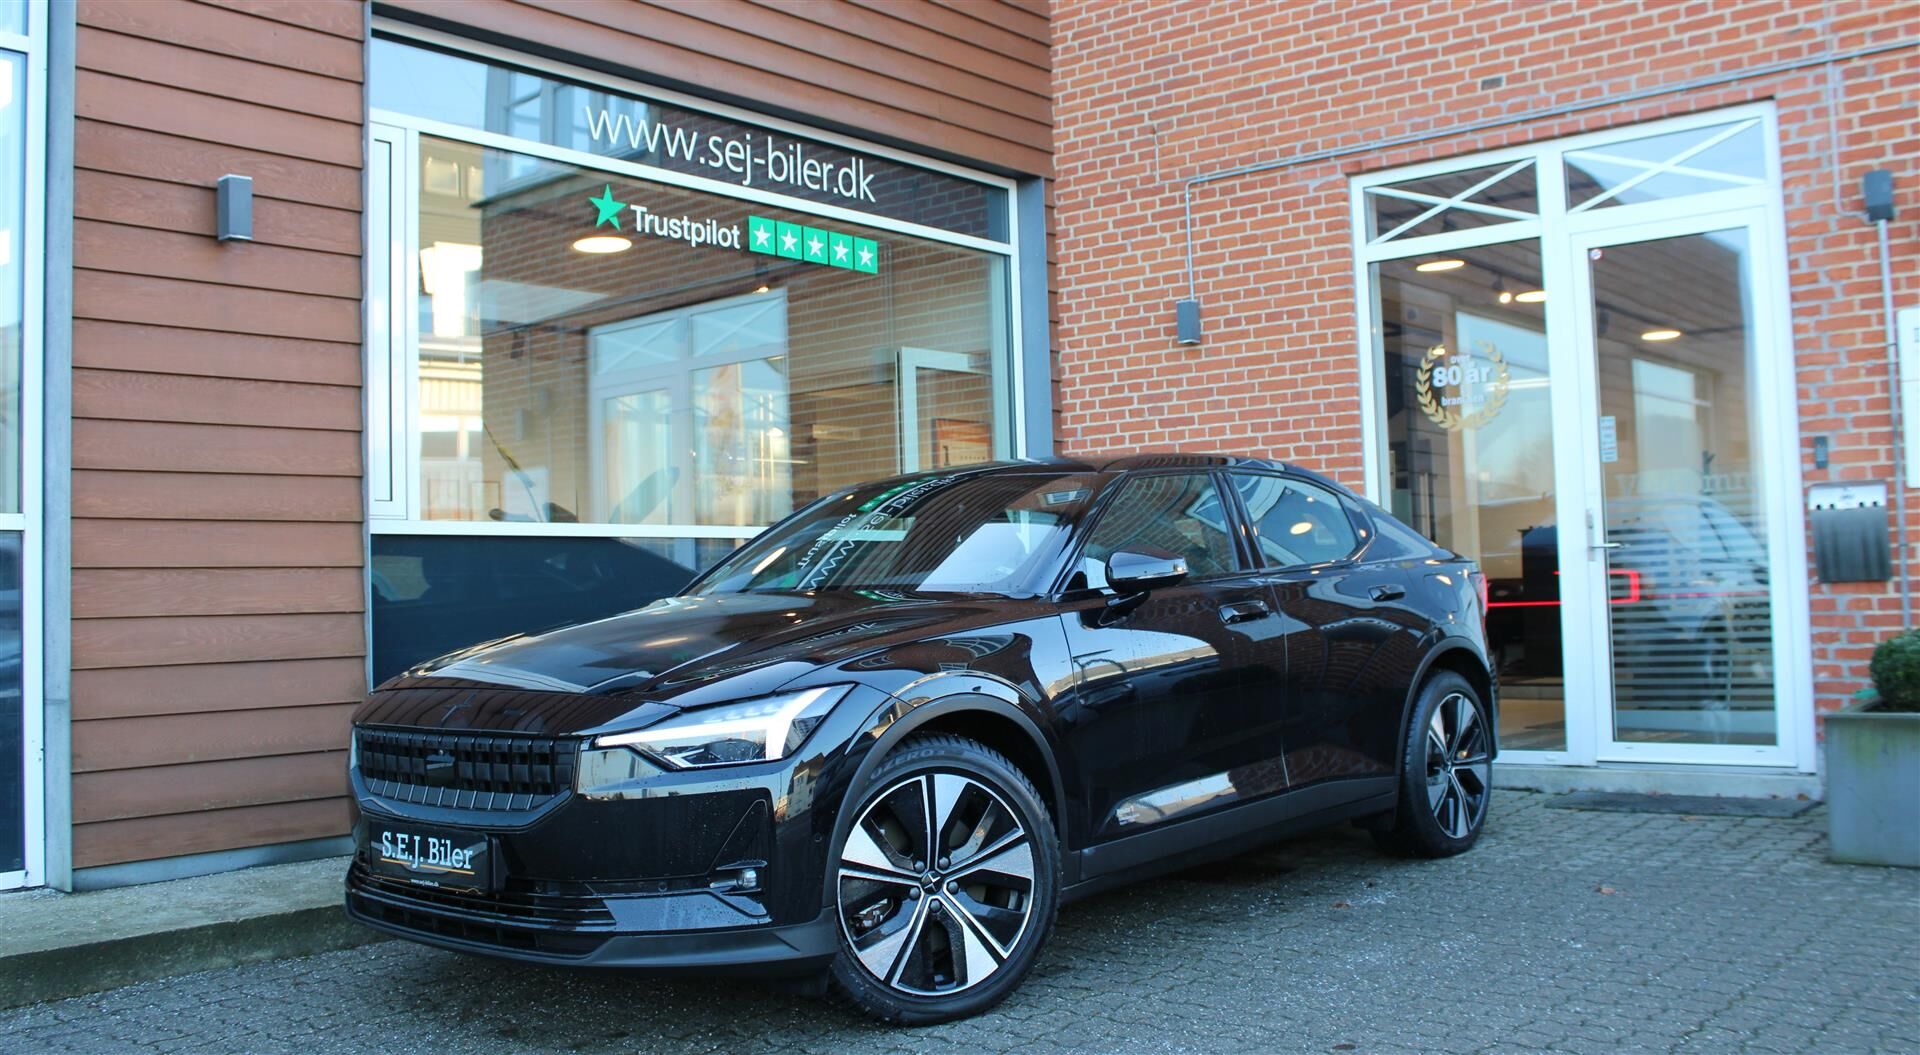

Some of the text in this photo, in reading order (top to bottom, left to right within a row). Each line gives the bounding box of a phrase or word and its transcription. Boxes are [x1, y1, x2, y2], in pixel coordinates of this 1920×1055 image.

[585, 106, 876, 202] www.sej-biler.dk
[630, 204, 740, 249] Trustpilot
[1433, 366, 1461, 387] 80
[381, 831, 473, 869] S.E.J. Biler
